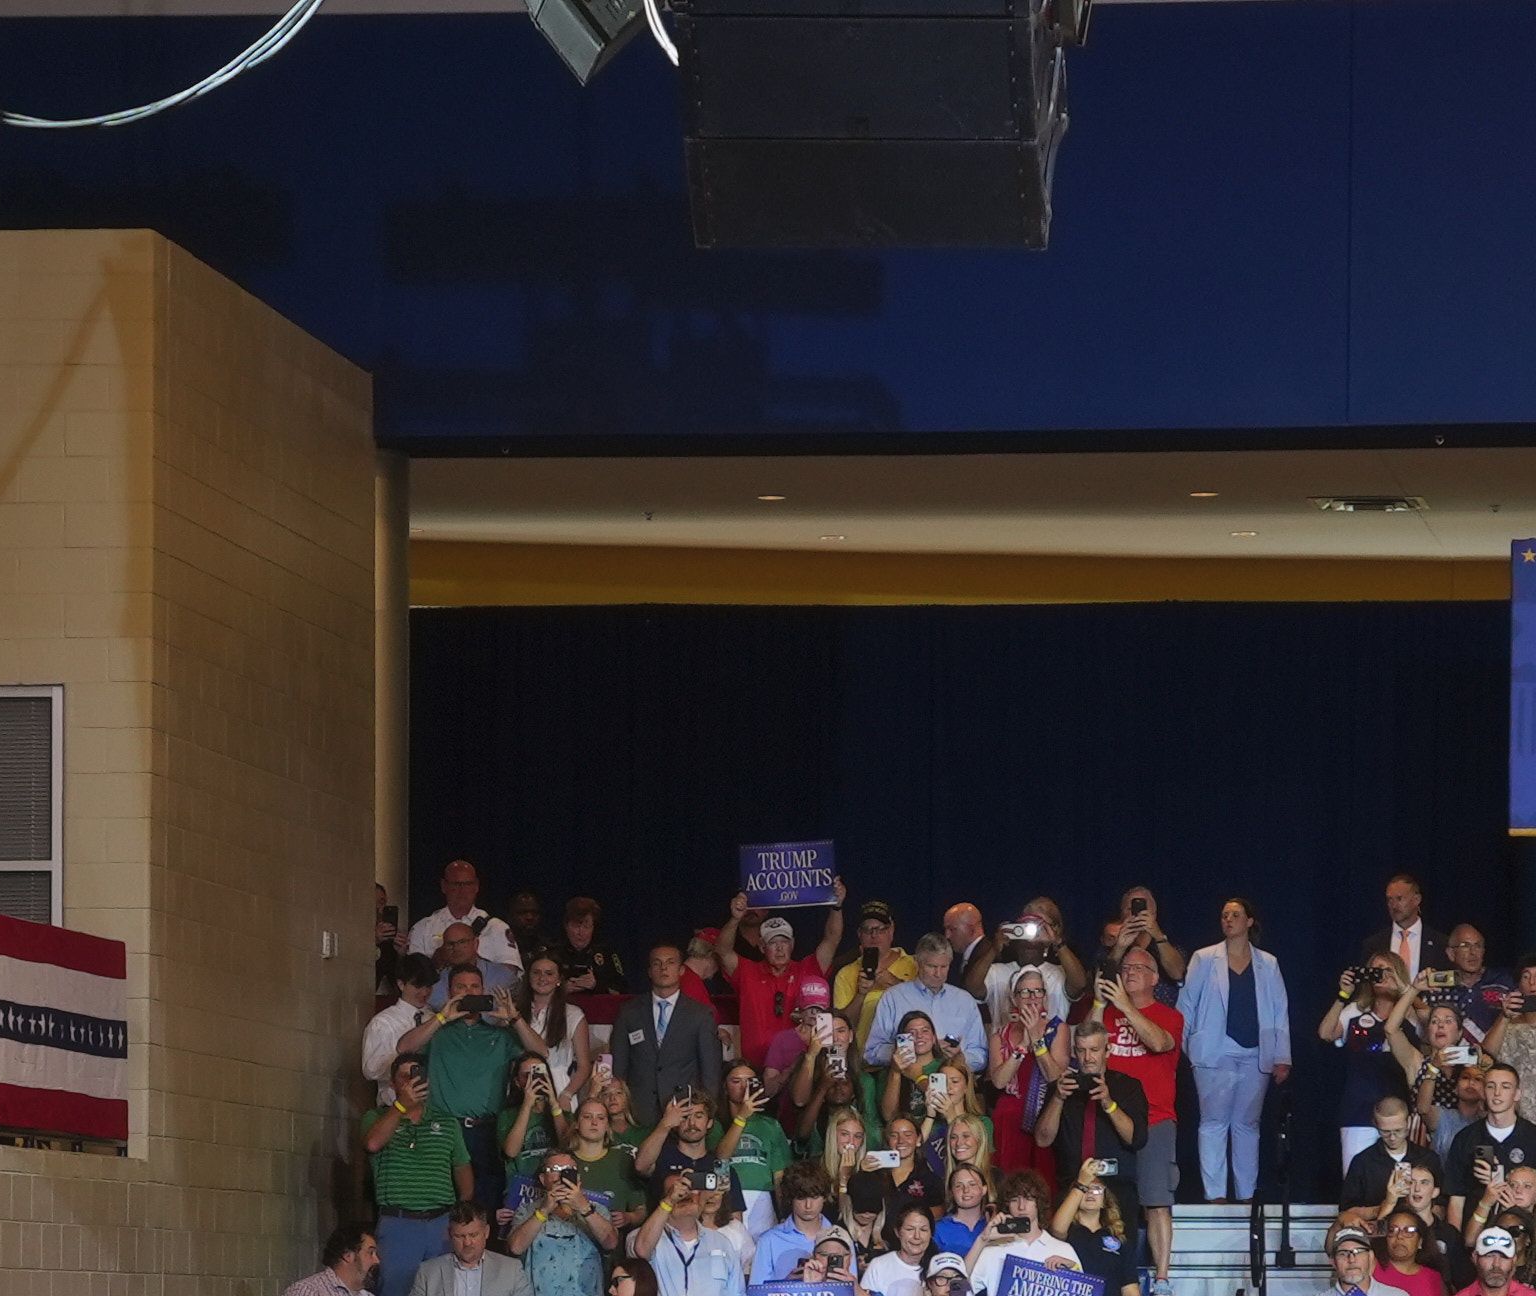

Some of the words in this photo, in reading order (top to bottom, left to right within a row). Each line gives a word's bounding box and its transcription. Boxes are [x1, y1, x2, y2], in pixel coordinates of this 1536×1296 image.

[757, 849, 818, 871] TRUMP
[746, 868, 834, 892] ACCOUNTS
[1011, 1265, 1070, 1292] POWERING
